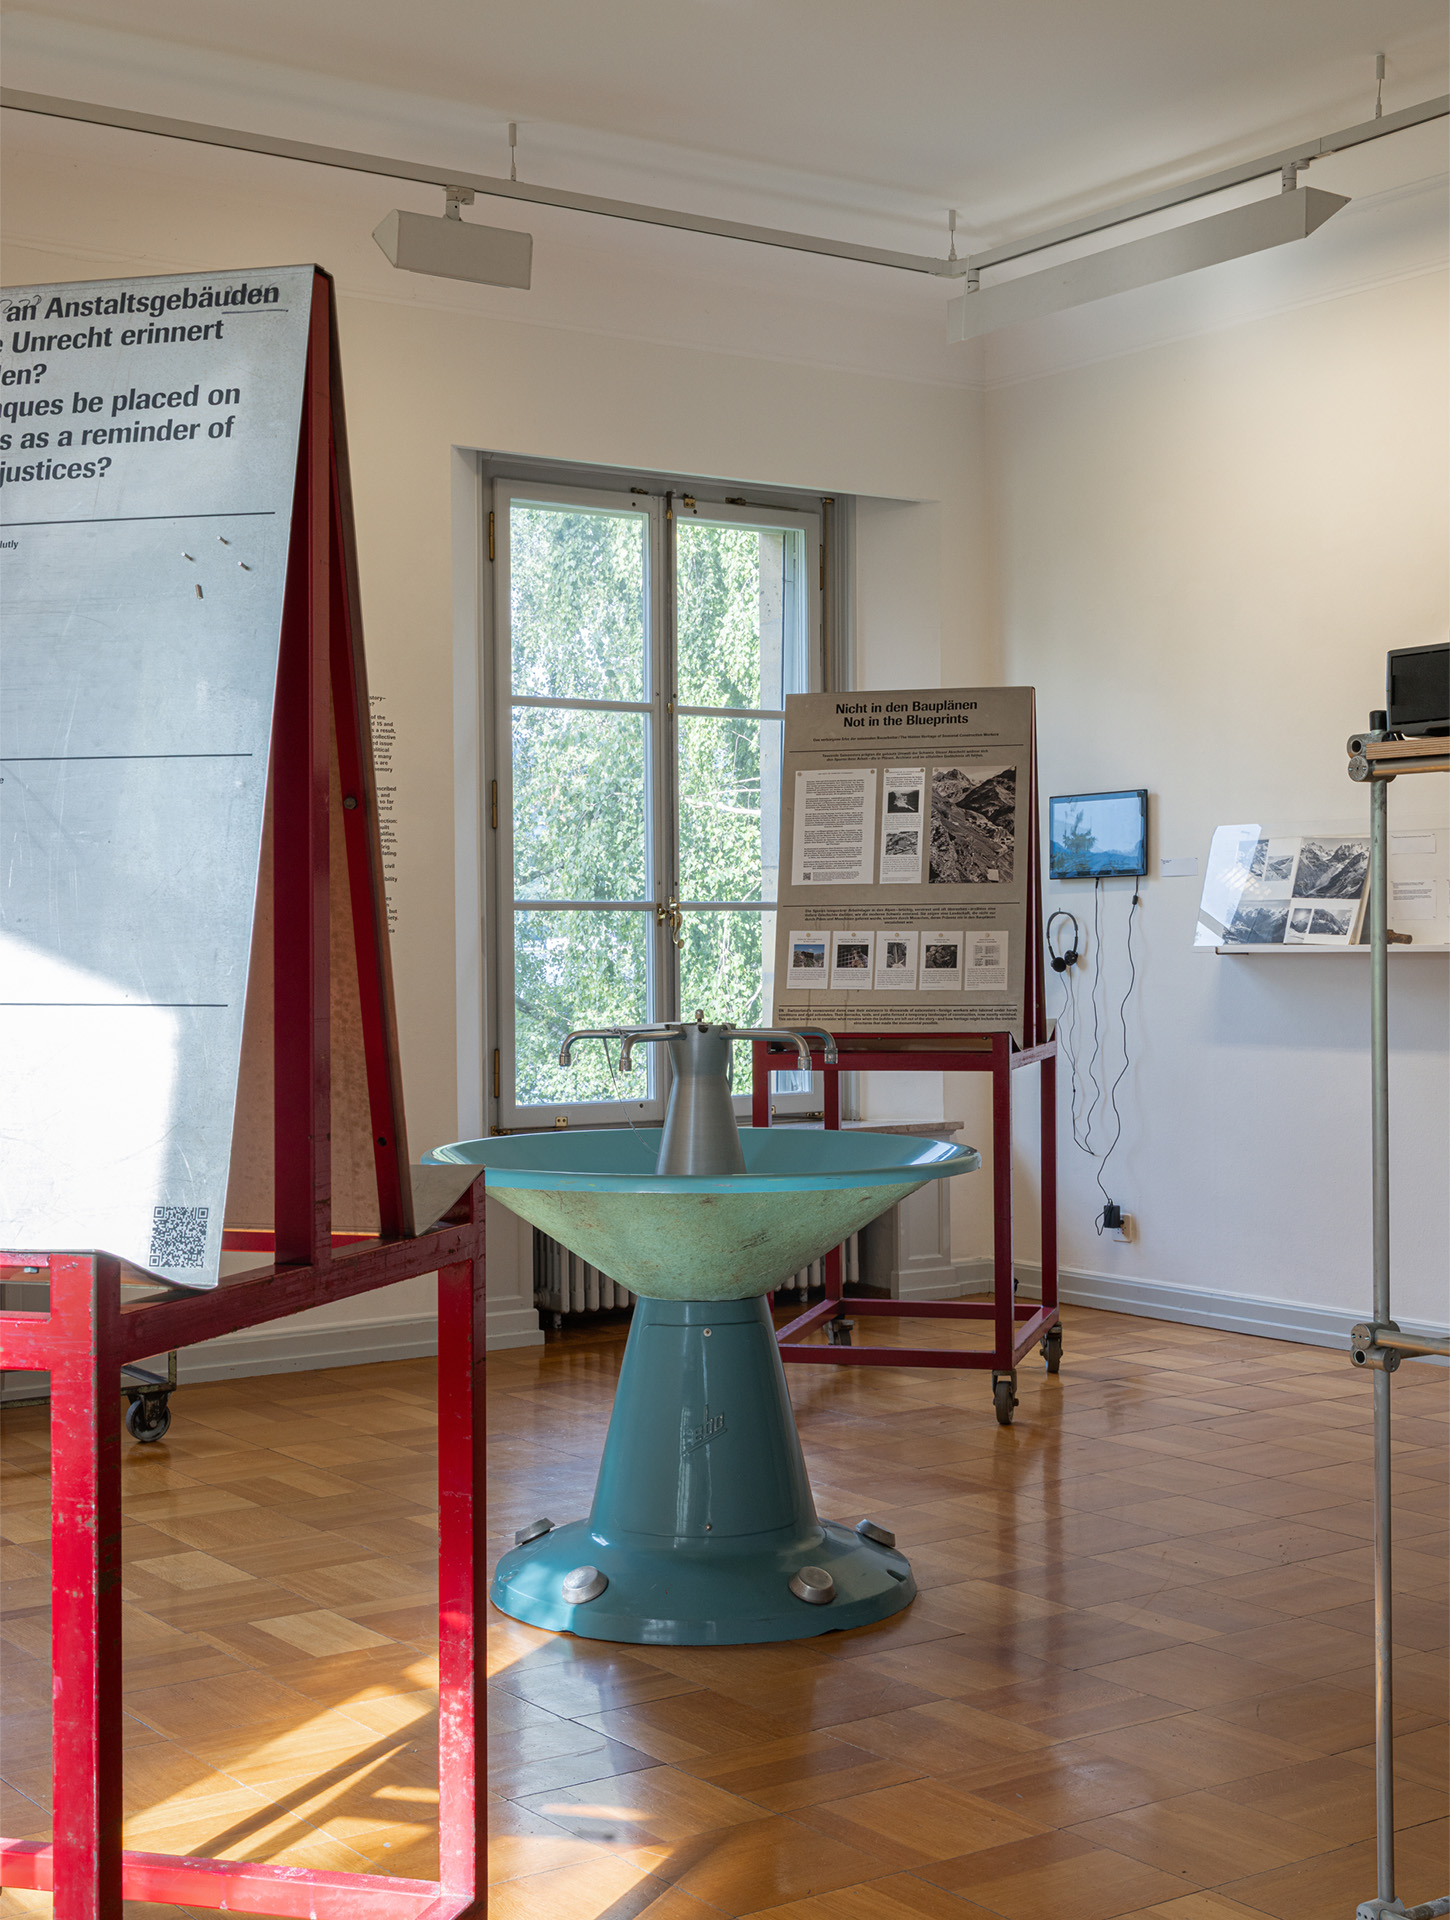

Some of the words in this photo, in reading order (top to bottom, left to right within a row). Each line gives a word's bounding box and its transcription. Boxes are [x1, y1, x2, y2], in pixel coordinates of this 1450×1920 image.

[6, 303, 36, 322] an
[44, 284, 279, 319] Anstaltsgebäuden
[12, 327, 112, 353] Unrecht
[121, 320, 224, 345] erinnert
[0, 364, 46, 385] en?
[0, 399, 63, 423] ques
[72, 392, 102, 413] be
[112, 385, 199, 417] placed
[209, 389, 240, 405] on
[21, 432, 49, 449] as
[58, 431, 72, 446] a
[82, 420, 200, 445] reminder
[209, 416, 235, 438] of
[0, 458, 111, 487] justices?
[836, 704, 867, 714] Nicht
[871, 703, 882, 713] in
[886, 702, 908, 712] den
[912, 700, 977, 714] Bauplänen
[844, 717, 865, 727] Not
[869, 716, 879, 726] in
[883, 716, 902, 726] the
[907, 714, 968, 727] Blueprints
